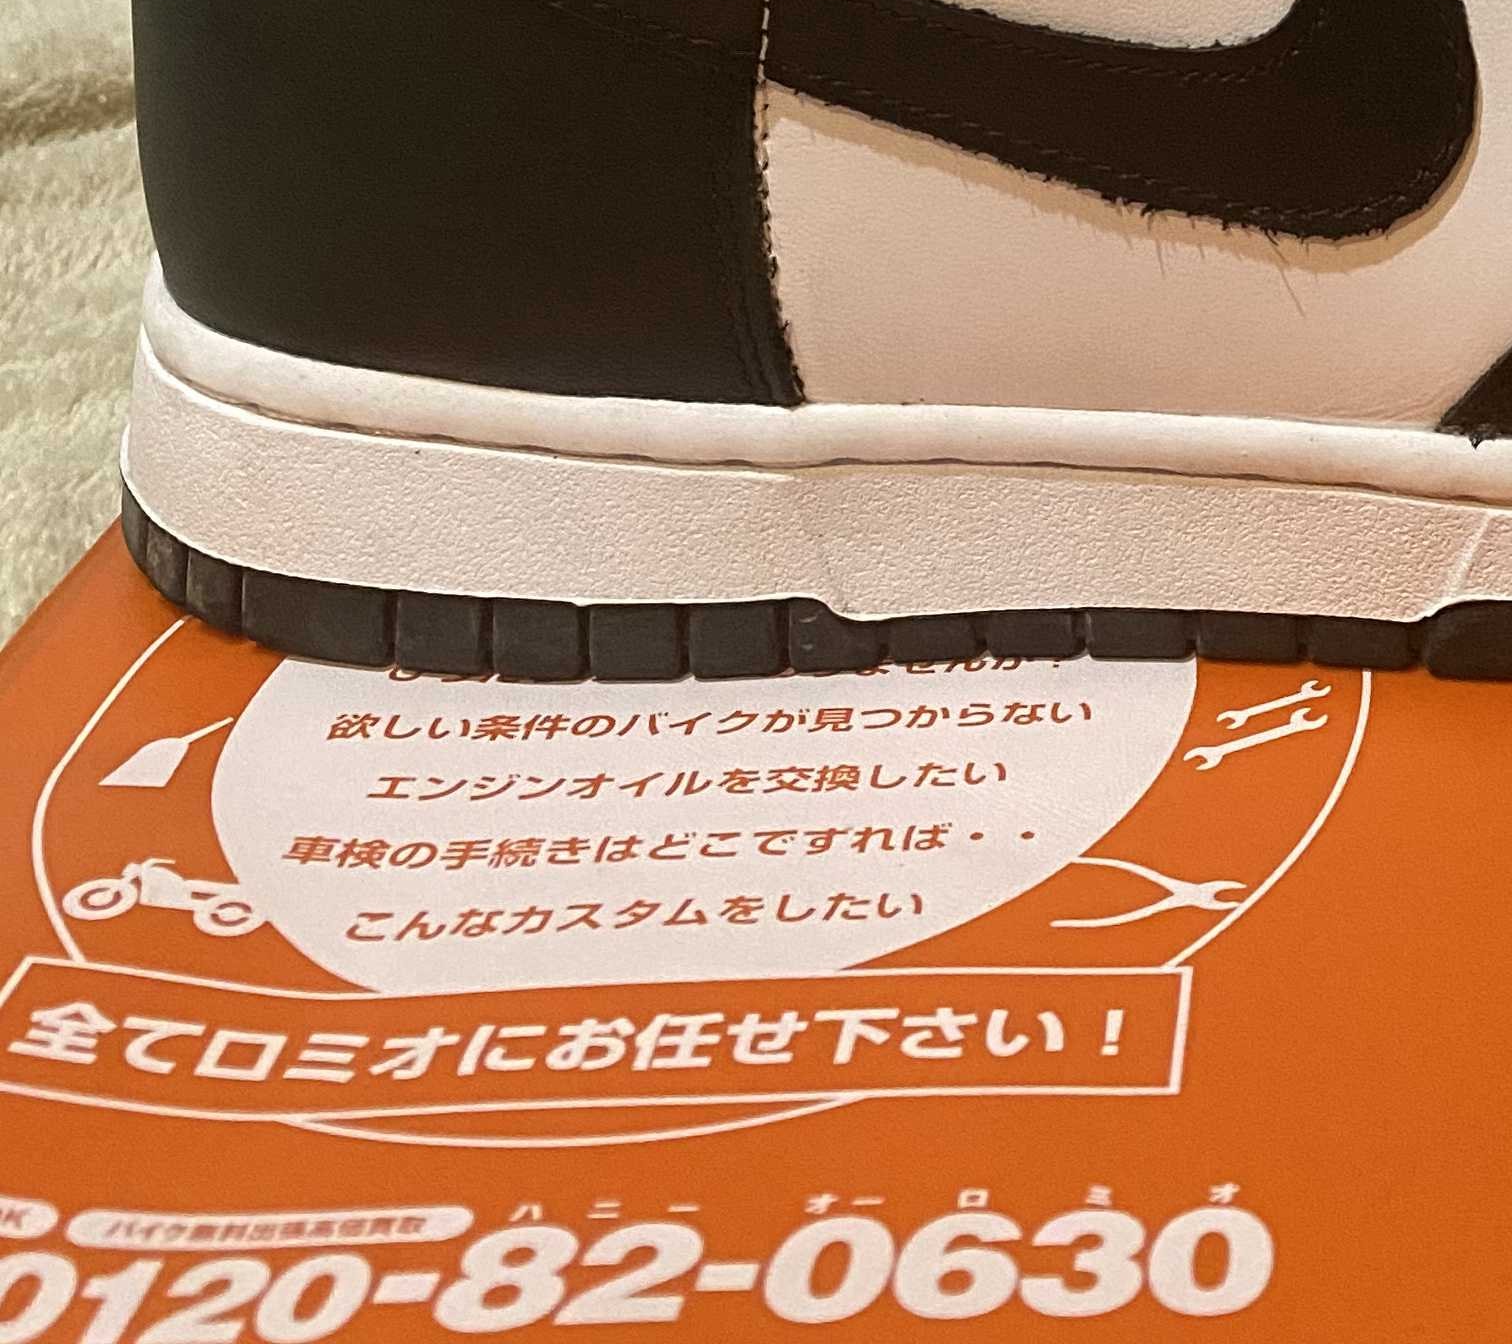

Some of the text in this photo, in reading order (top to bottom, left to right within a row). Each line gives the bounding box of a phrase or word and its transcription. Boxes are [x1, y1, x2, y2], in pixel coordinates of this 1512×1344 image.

[326, 701, 1092, 742] 欲しい条件のバイクが見つからない
[367, 762, 1007, 801] エンジンオイルを交換したい
[345, 891, 924, 942] こんなカスタムをしたい
[0, 1207, 1274, 1344] 0120-82-0630
